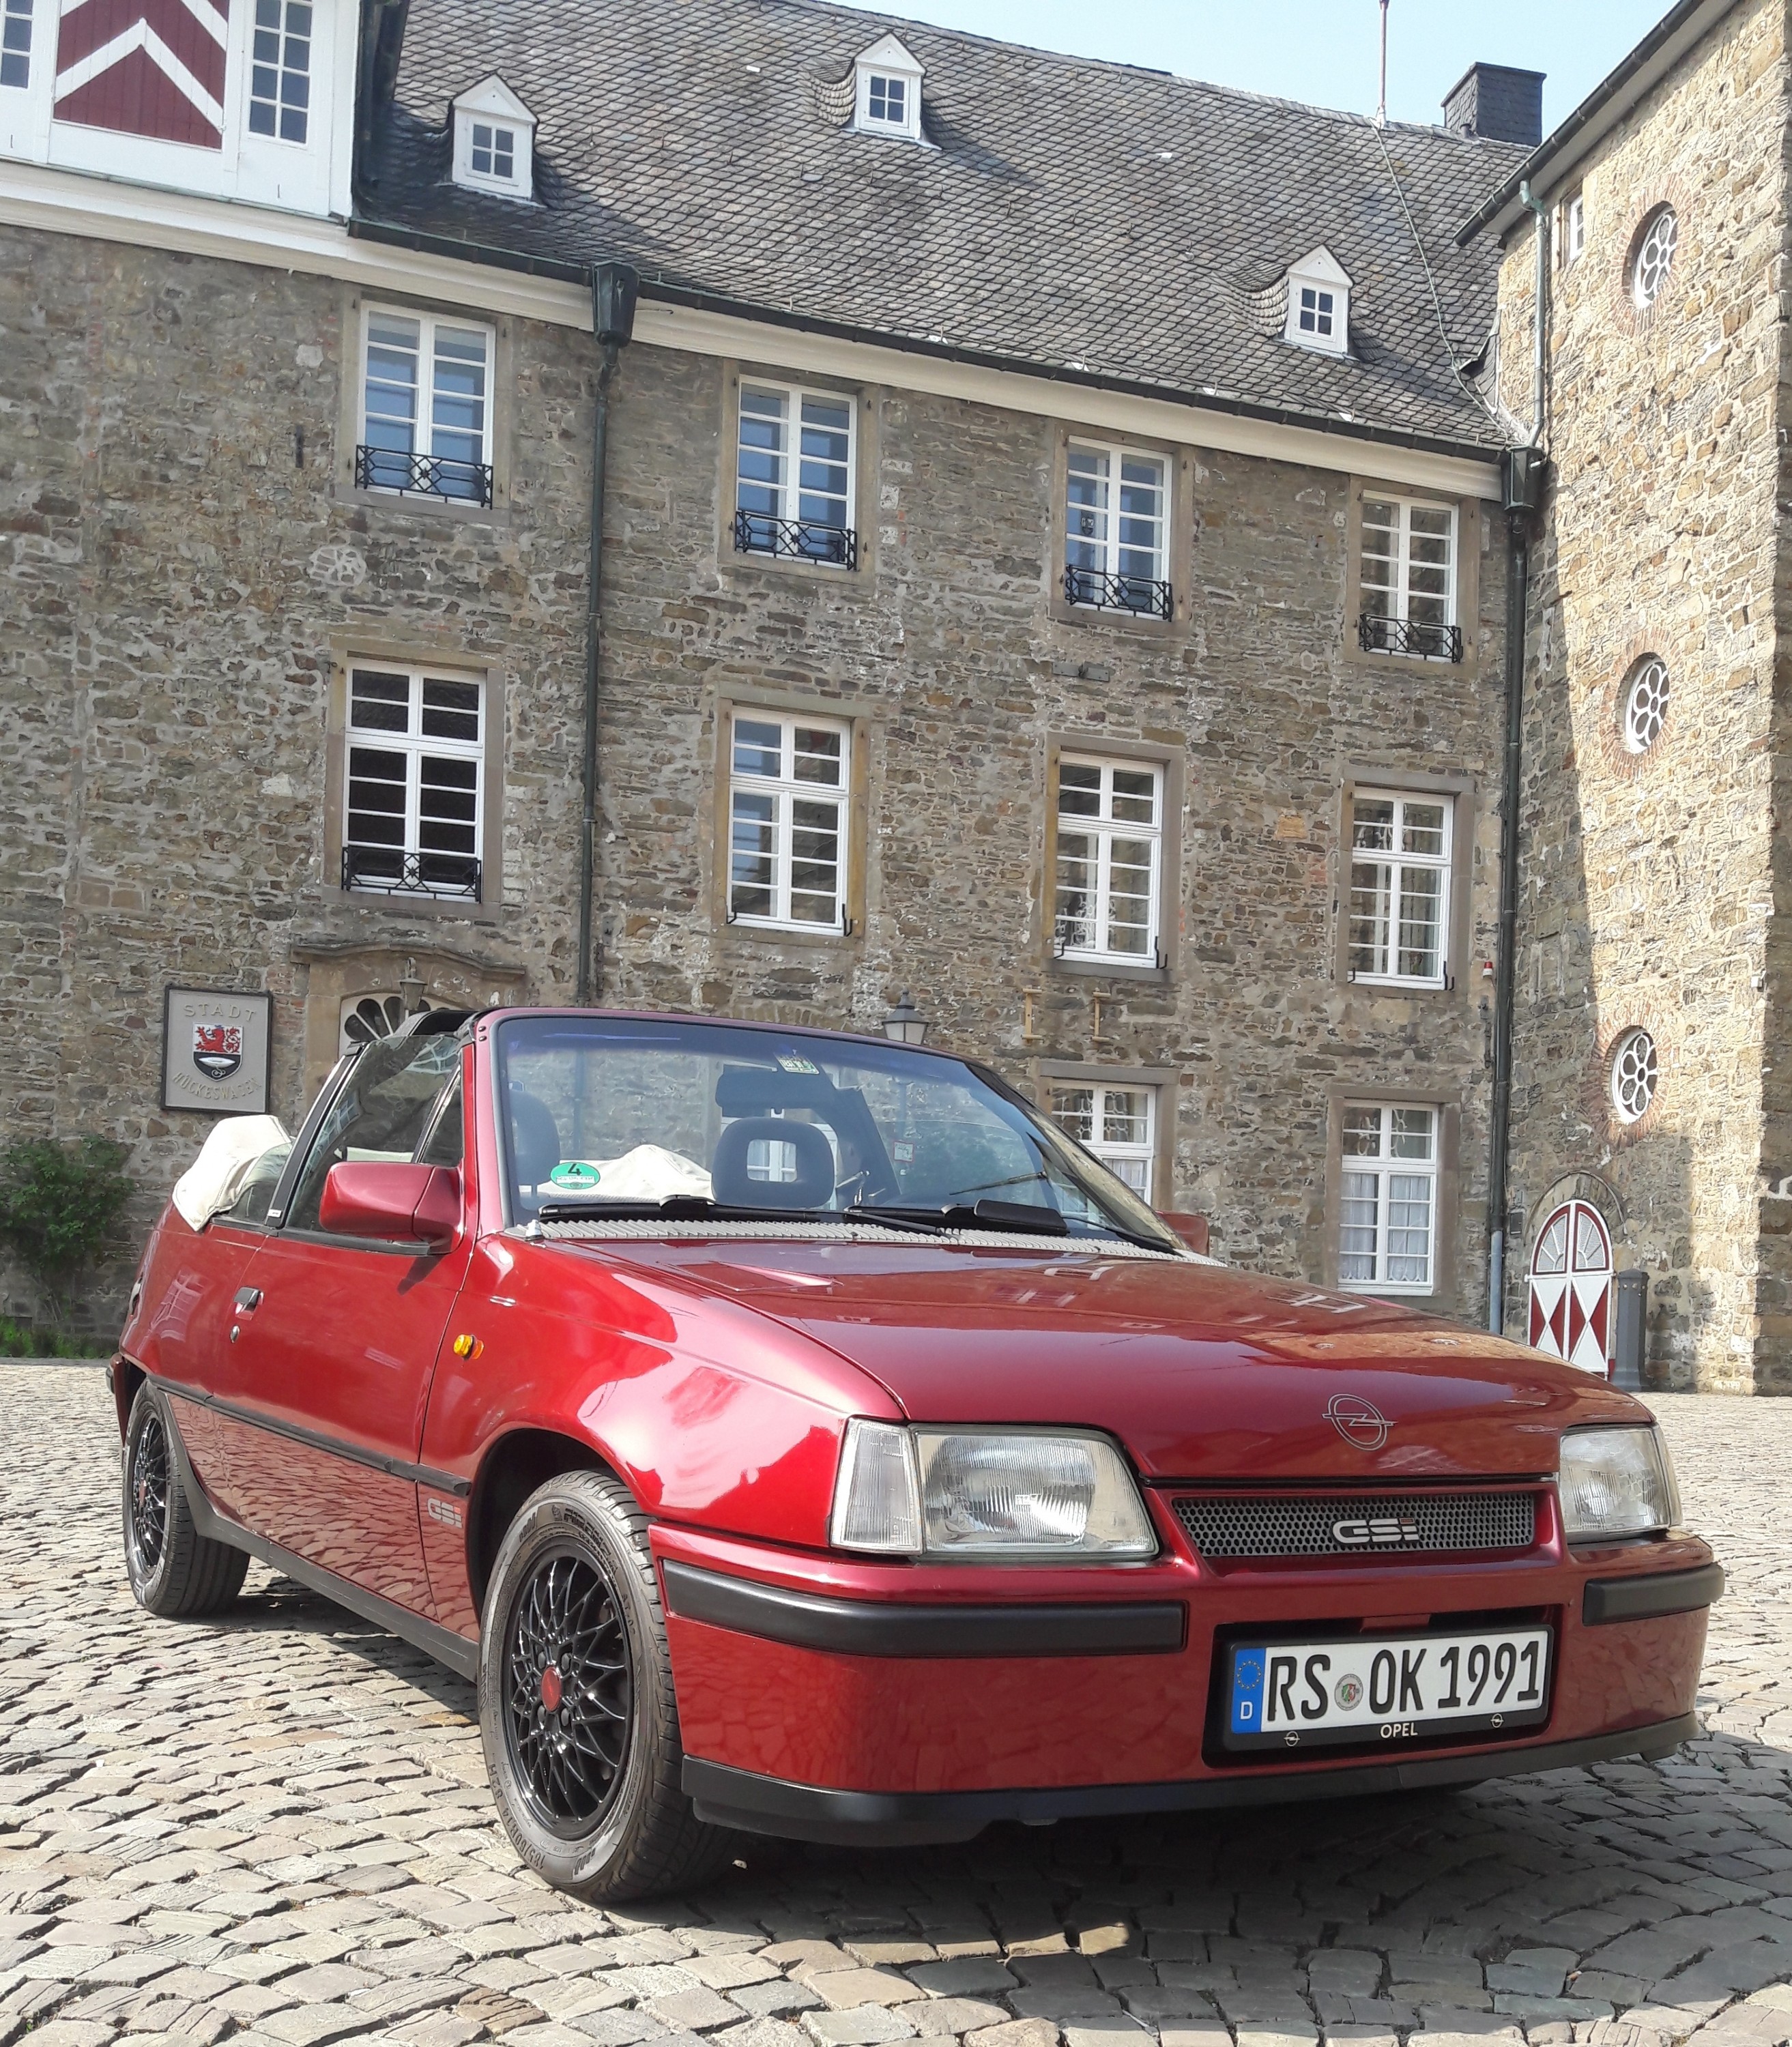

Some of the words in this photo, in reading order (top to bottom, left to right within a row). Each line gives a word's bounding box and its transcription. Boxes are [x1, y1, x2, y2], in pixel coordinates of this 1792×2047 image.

[184, 1003, 257, 1021] STADT
[568, 1163, 582, 1176] 4
[1267, 1654, 1331, 1722] RS
[1369, 1648, 1427, 1714] OK
[1438, 1640, 1540, 1709] 1991
[1240, 1700, 1254, 1720] D
[1381, 1722, 1419, 1739] OPEL
